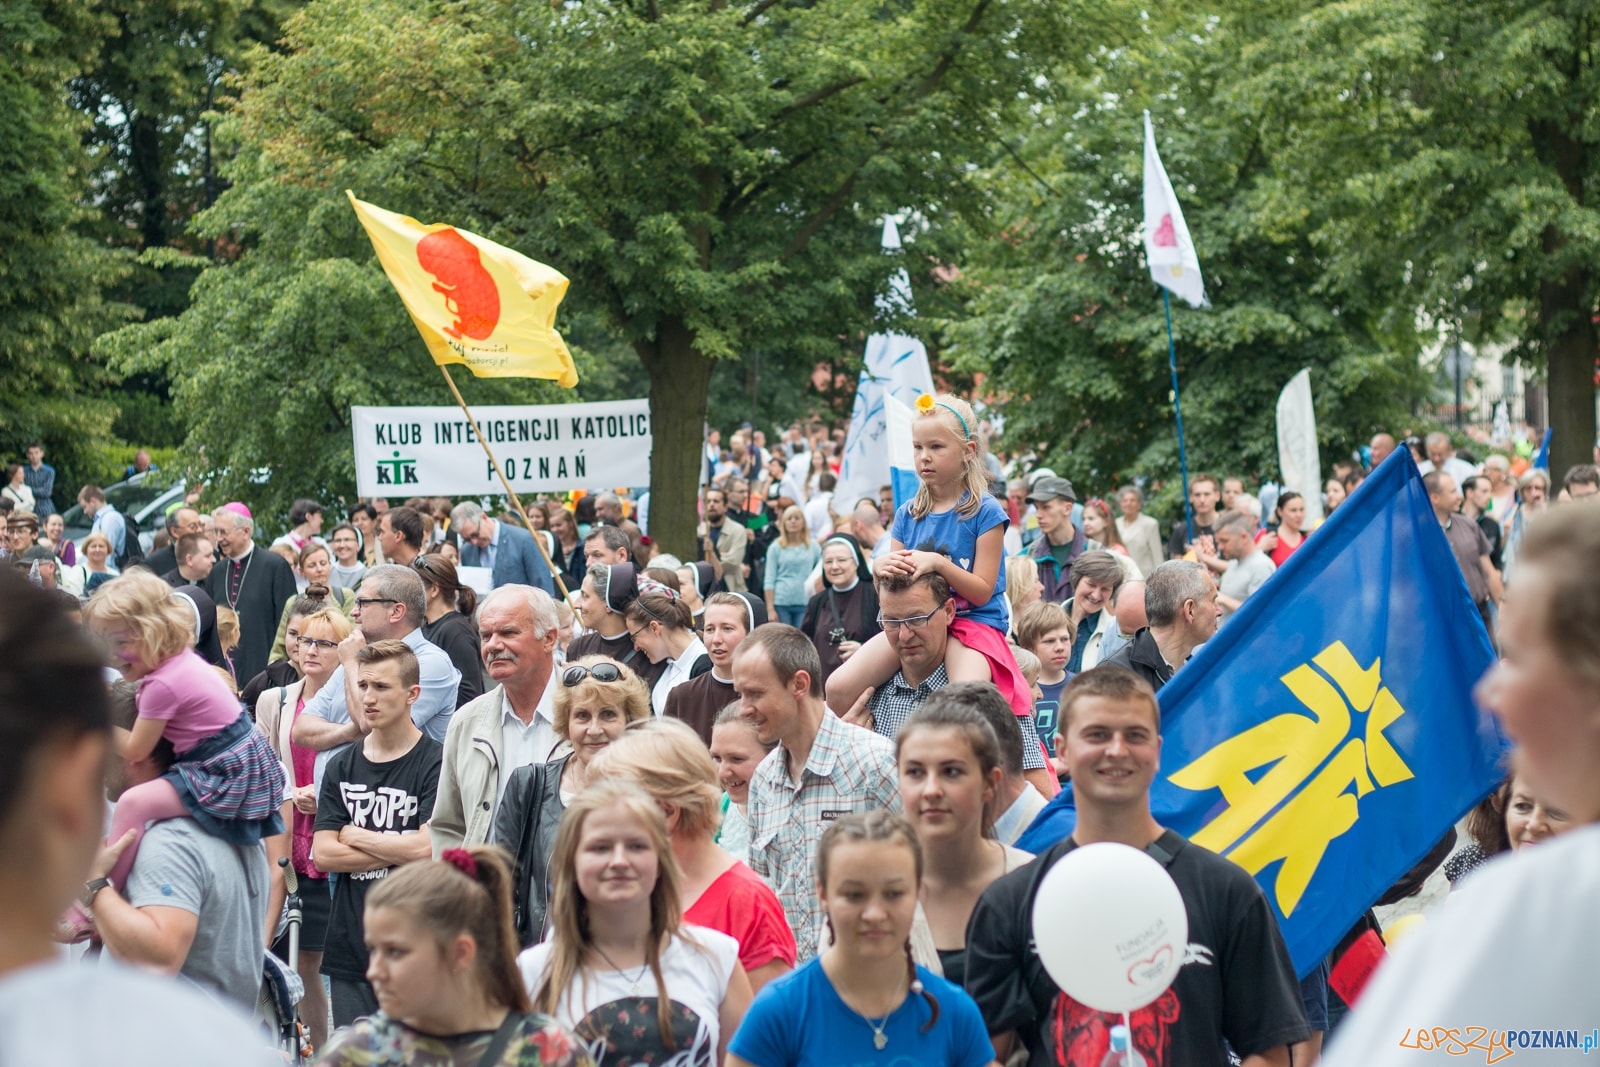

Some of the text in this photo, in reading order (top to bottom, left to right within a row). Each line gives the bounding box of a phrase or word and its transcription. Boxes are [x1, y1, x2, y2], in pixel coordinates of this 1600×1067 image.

[376, 423, 422, 445] KLUB
[435, 418, 559, 444] INTELIGENCJI
[487, 449, 587, 481] POZNAŃ
